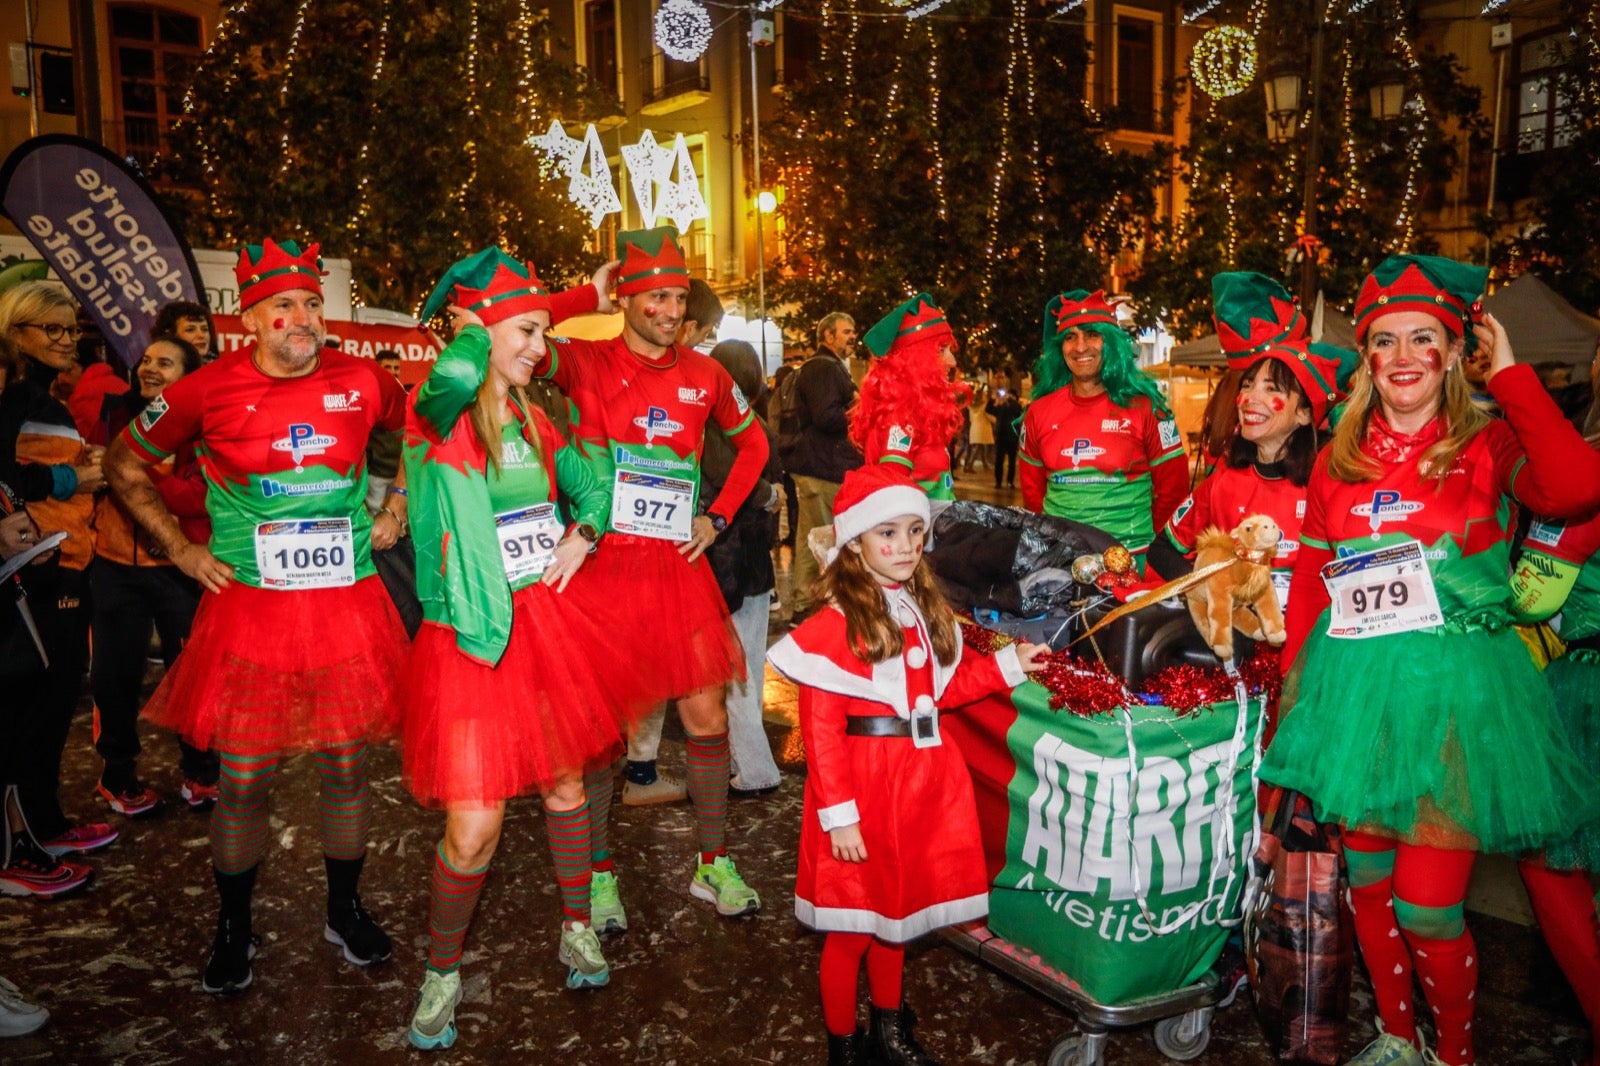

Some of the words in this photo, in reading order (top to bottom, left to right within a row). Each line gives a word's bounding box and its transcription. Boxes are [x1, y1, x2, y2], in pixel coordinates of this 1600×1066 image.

[648, 406, 678, 431] Poncho
[290, 424, 330, 449] Poncho
[633, 498, 678, 522] 977
[1371, 491, 1415, 514] Poncho
[274, 545, 346, 570] 1060
[503, 532, 555, 559] 976
[1351, 581, 1409, 614] 979
